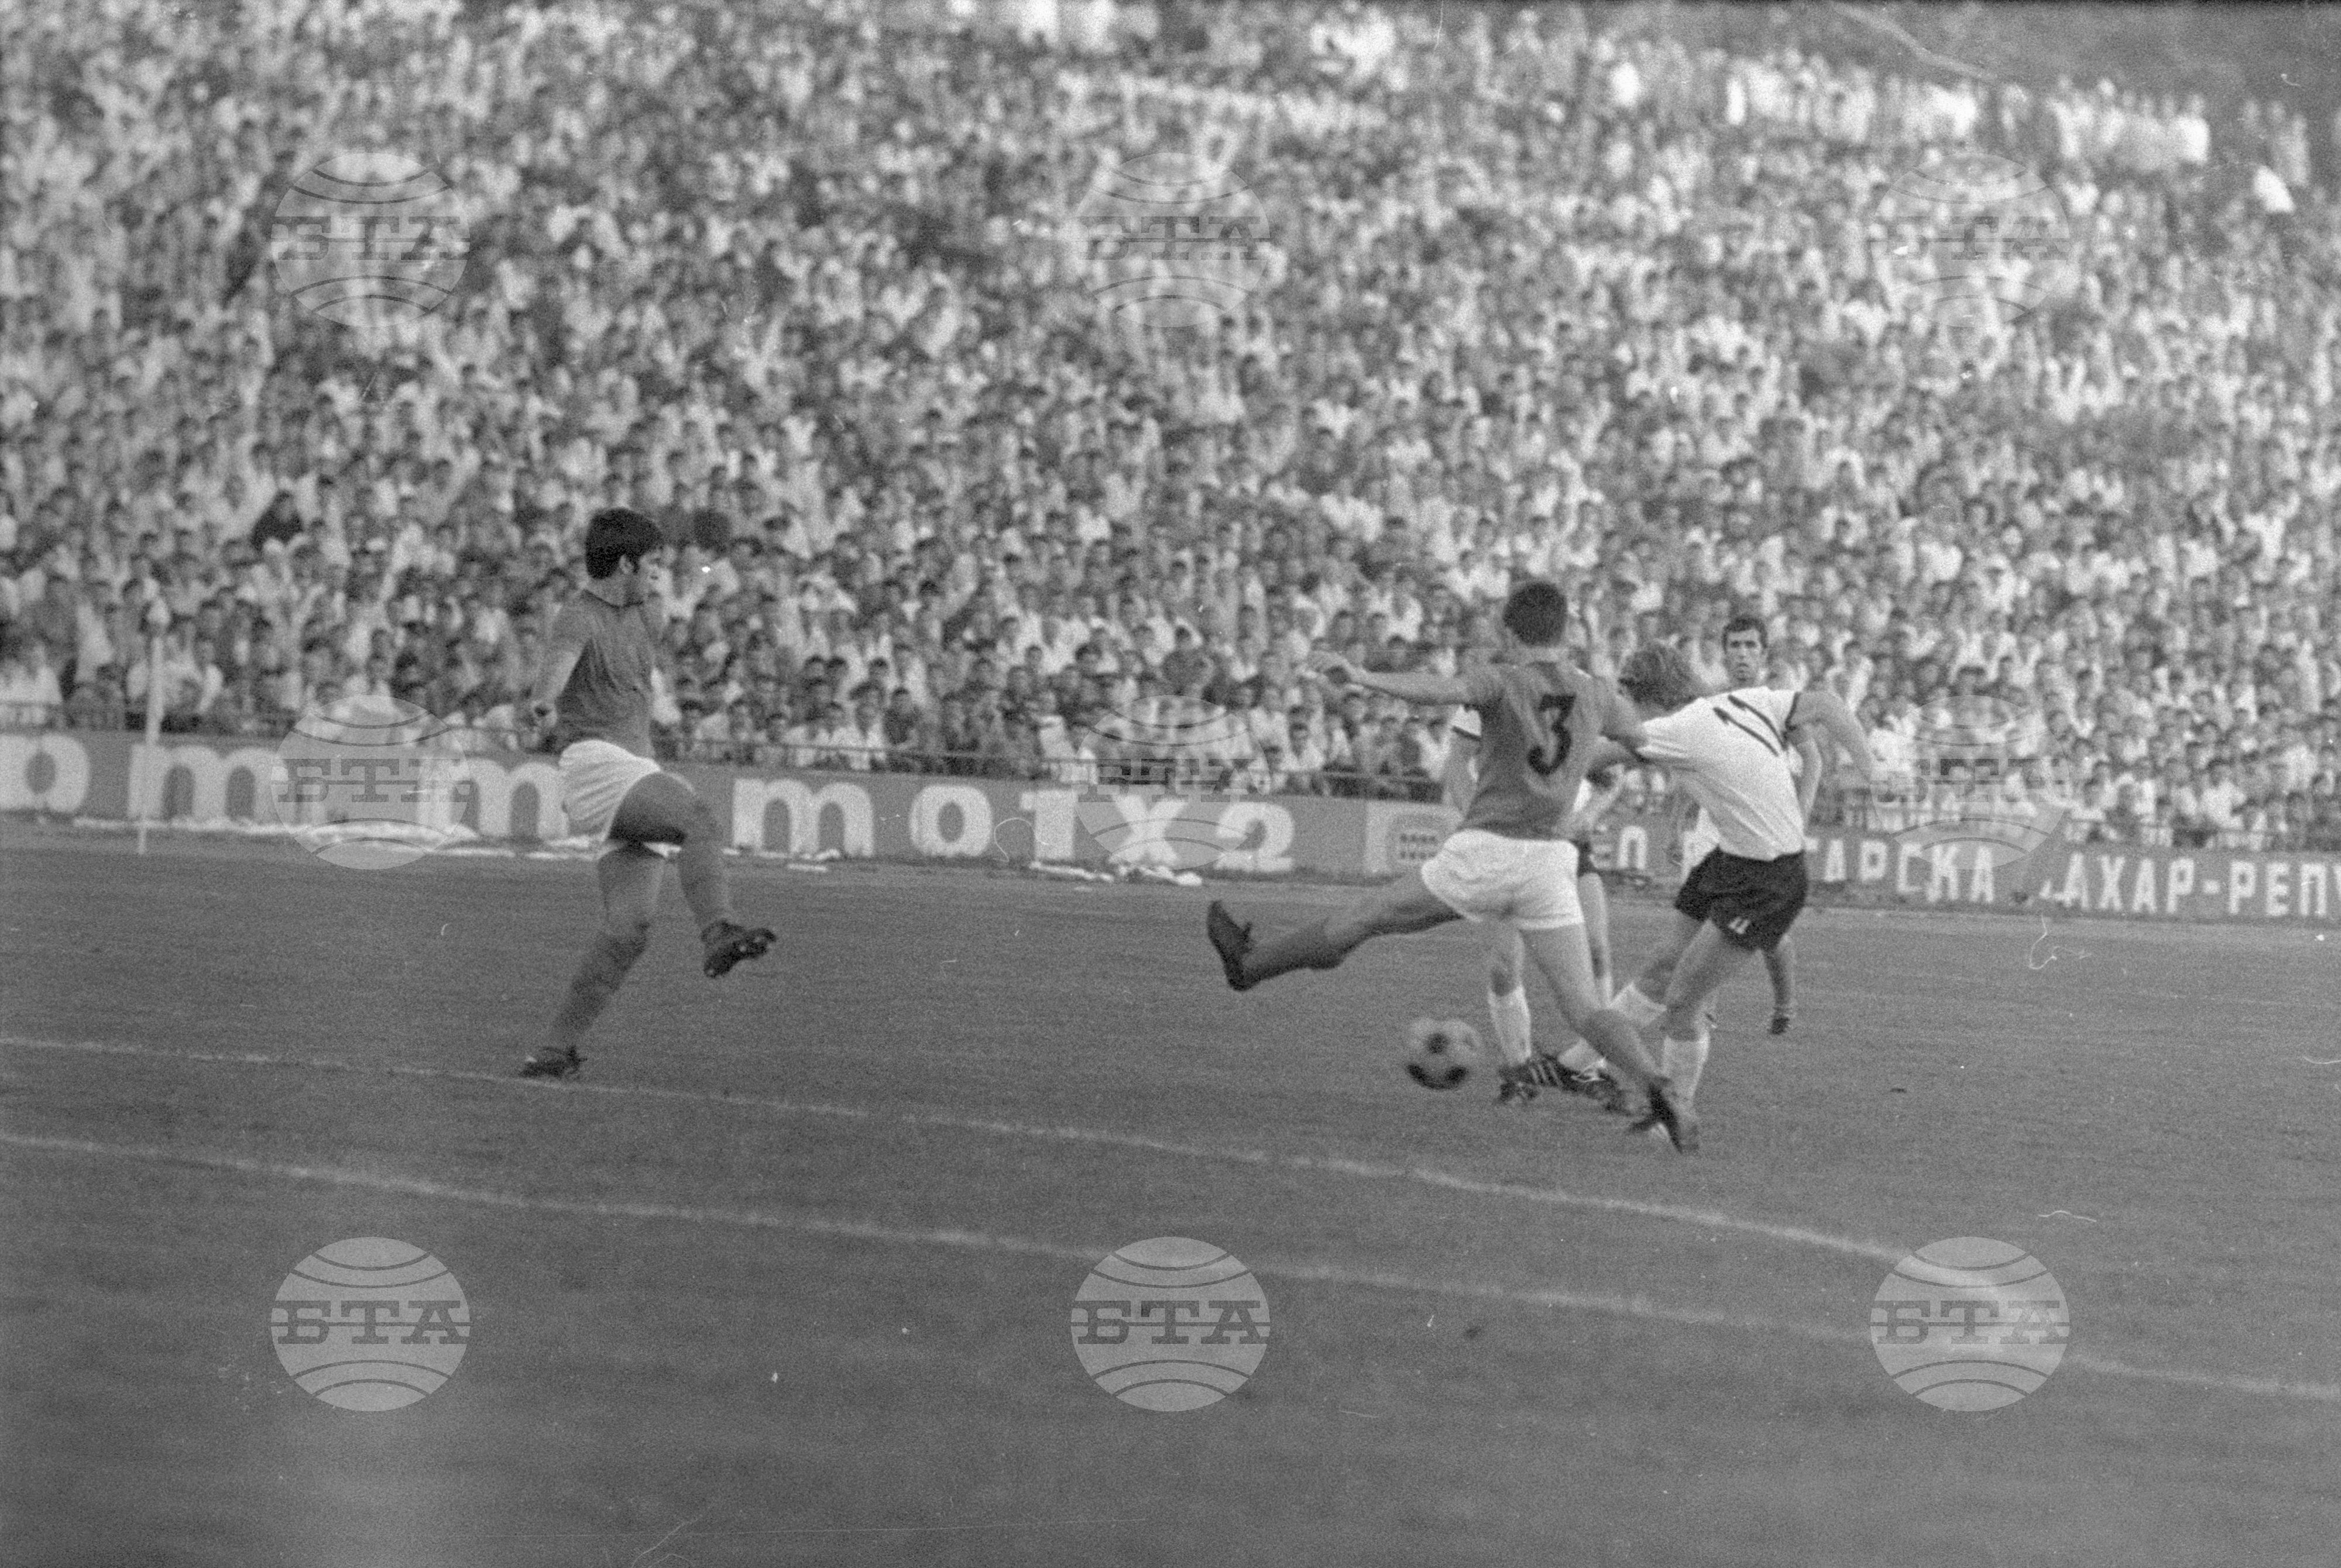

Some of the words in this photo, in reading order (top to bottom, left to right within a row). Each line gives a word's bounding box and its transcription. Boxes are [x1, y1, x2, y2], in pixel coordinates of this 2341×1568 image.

[1527, 694, 1575, 775] 3
[1805, 837, 1995, 903] АРСКА
[2039, 852, 2341, 919] АХАР-РЕП
